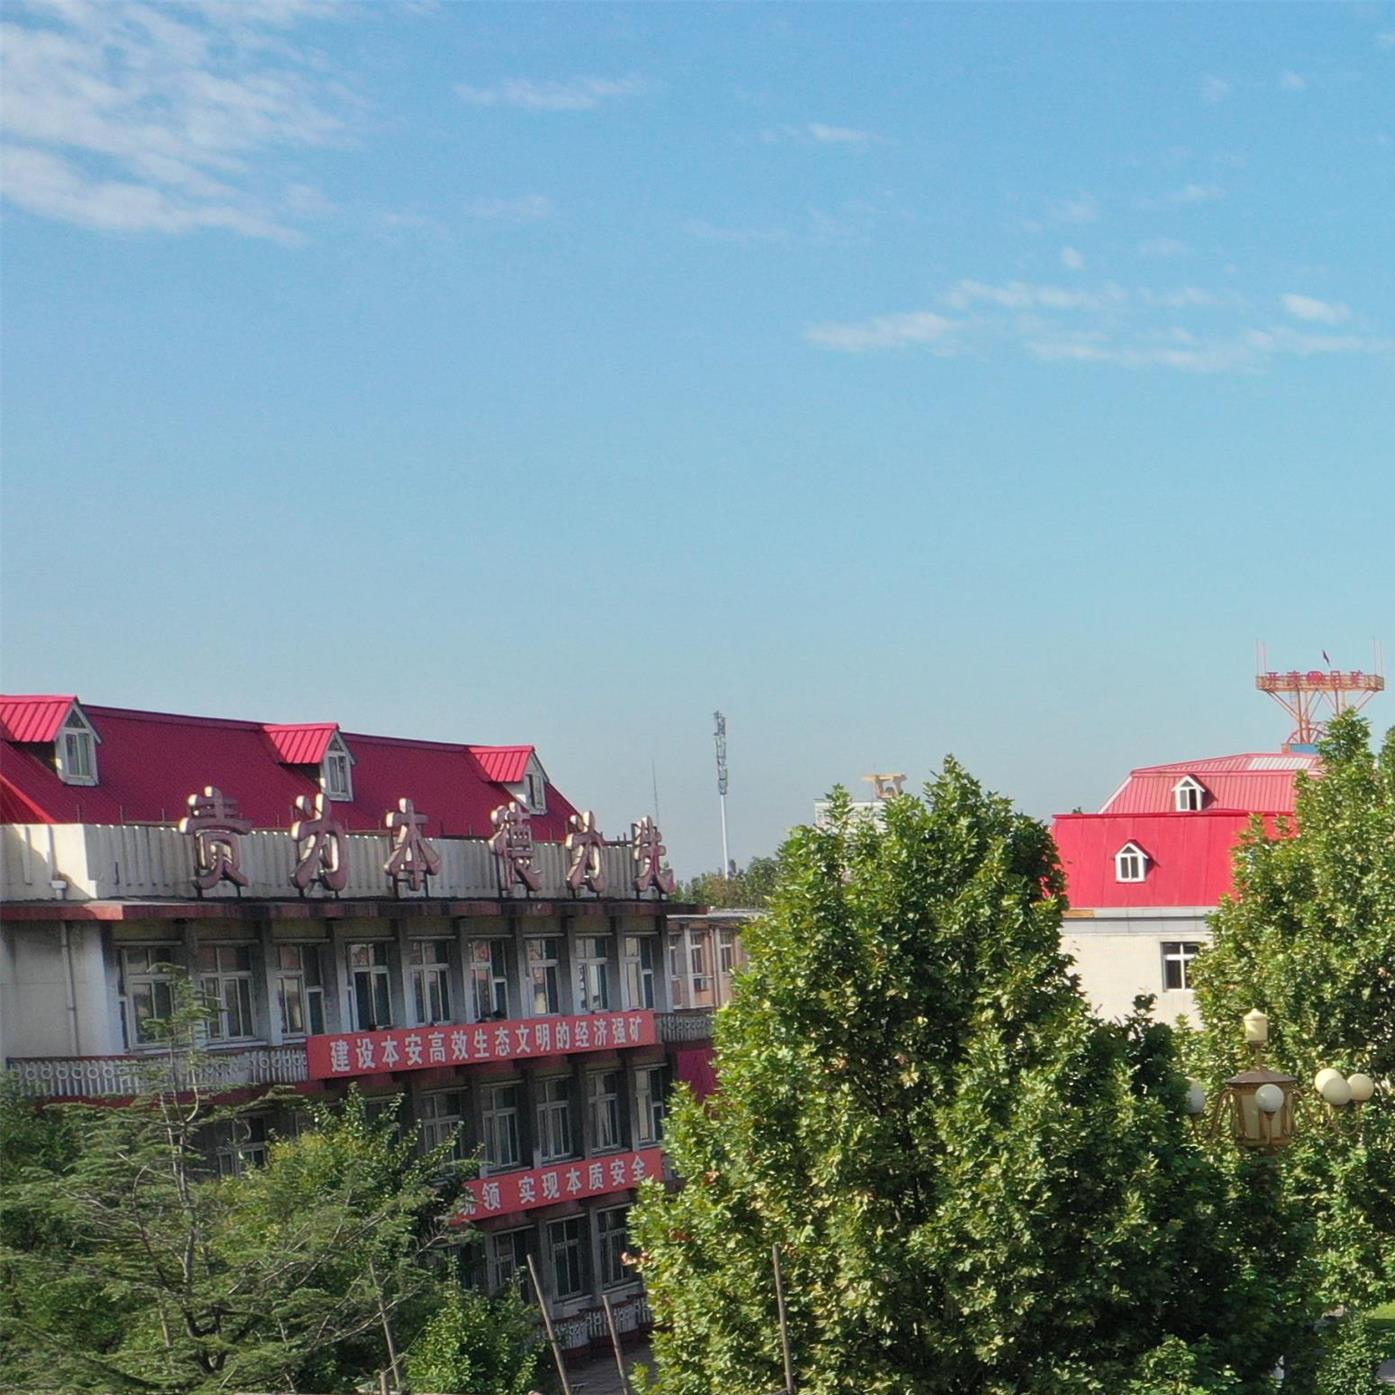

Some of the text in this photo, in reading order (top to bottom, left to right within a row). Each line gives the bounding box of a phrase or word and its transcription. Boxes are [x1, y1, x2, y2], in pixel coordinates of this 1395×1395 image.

[330, 1015, 643, 1073] 建设本安高效生态文明的经济强矿
[518, 1156, 646, 1204] 实现本质安全
